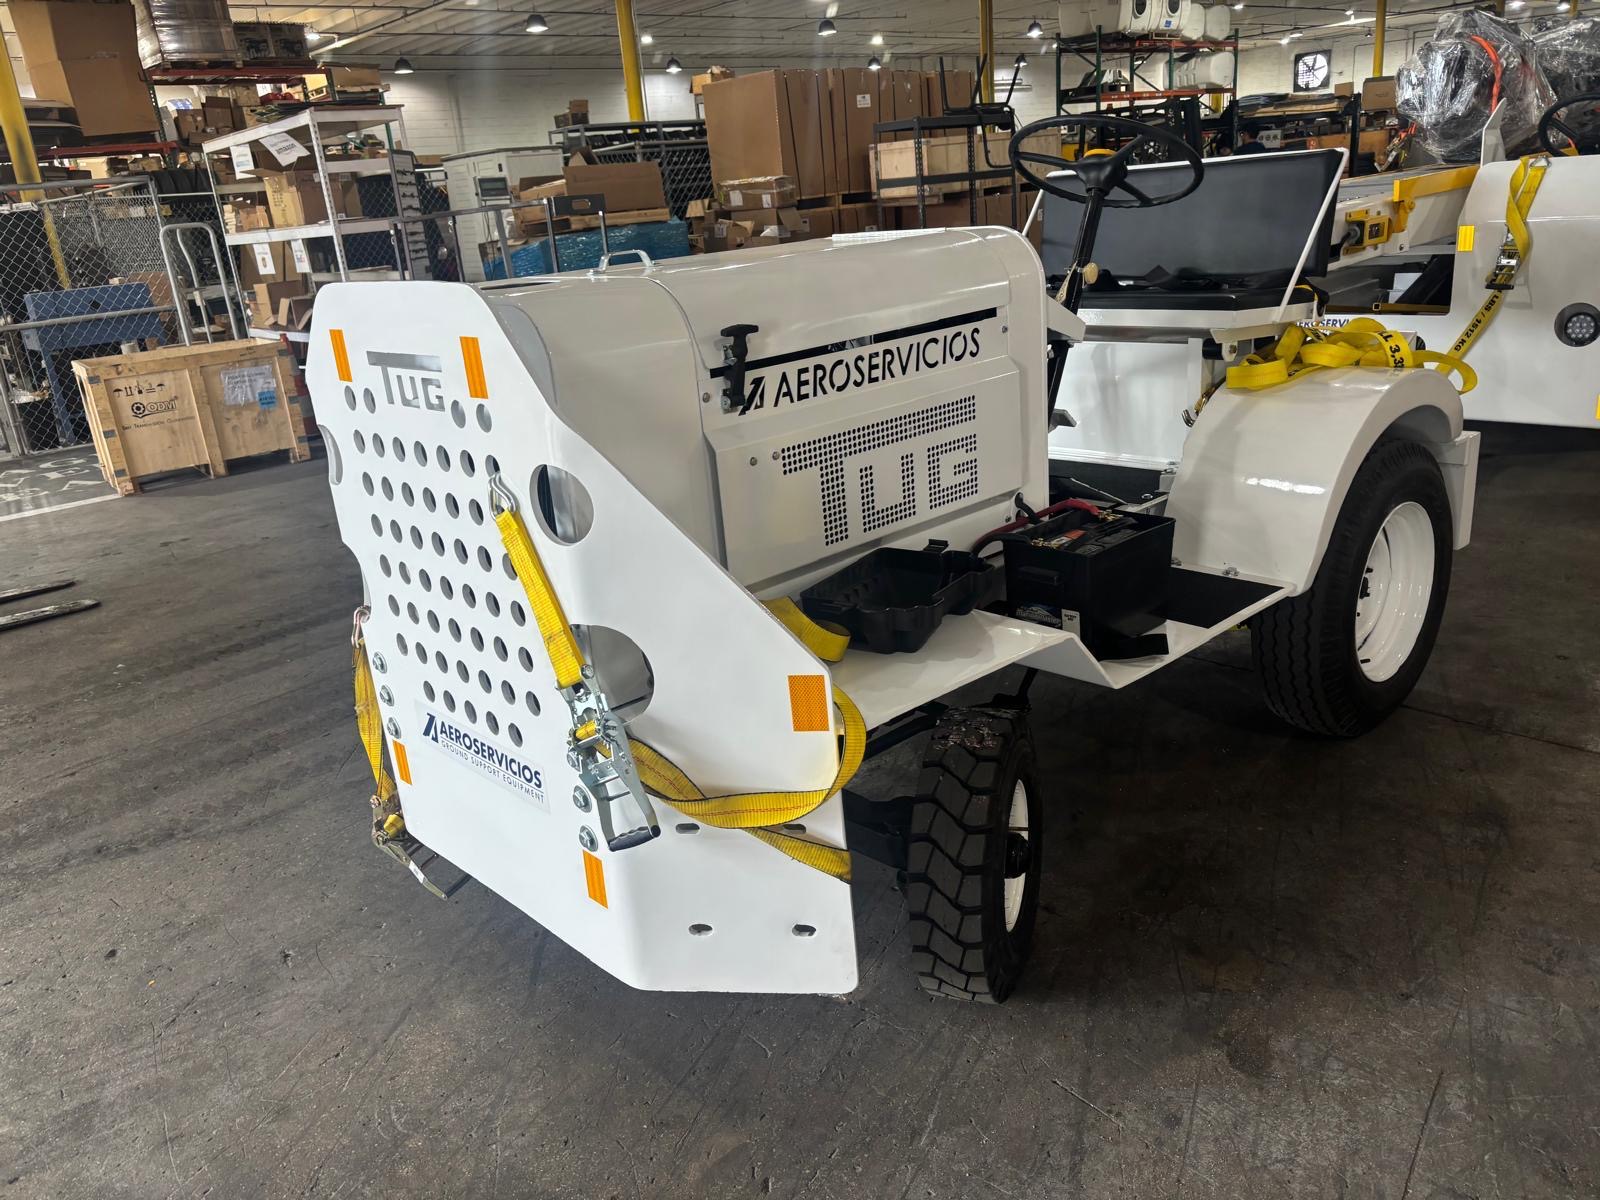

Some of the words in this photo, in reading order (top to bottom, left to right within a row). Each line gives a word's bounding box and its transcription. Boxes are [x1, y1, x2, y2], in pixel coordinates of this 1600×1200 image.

[1464, 318, 1482, 339] 1512
[1484, 294, 1499, 312] LBS
[774, 327, 980, 407] AEROSERVICIOS
[1454, 338, 1467, 352] KG
[146, 399, 177, 412] ODM
[366, 350, 446, 412] TUG
[781, 394, 978, 547] TUG
[440, 720, 542, 789] AEROSERVICIOS
[441, 740, 469, 761] GROUND
[471, 757, 500, 779] SUPPORT
[503, 774, 544, 804] EQUIPMENT
